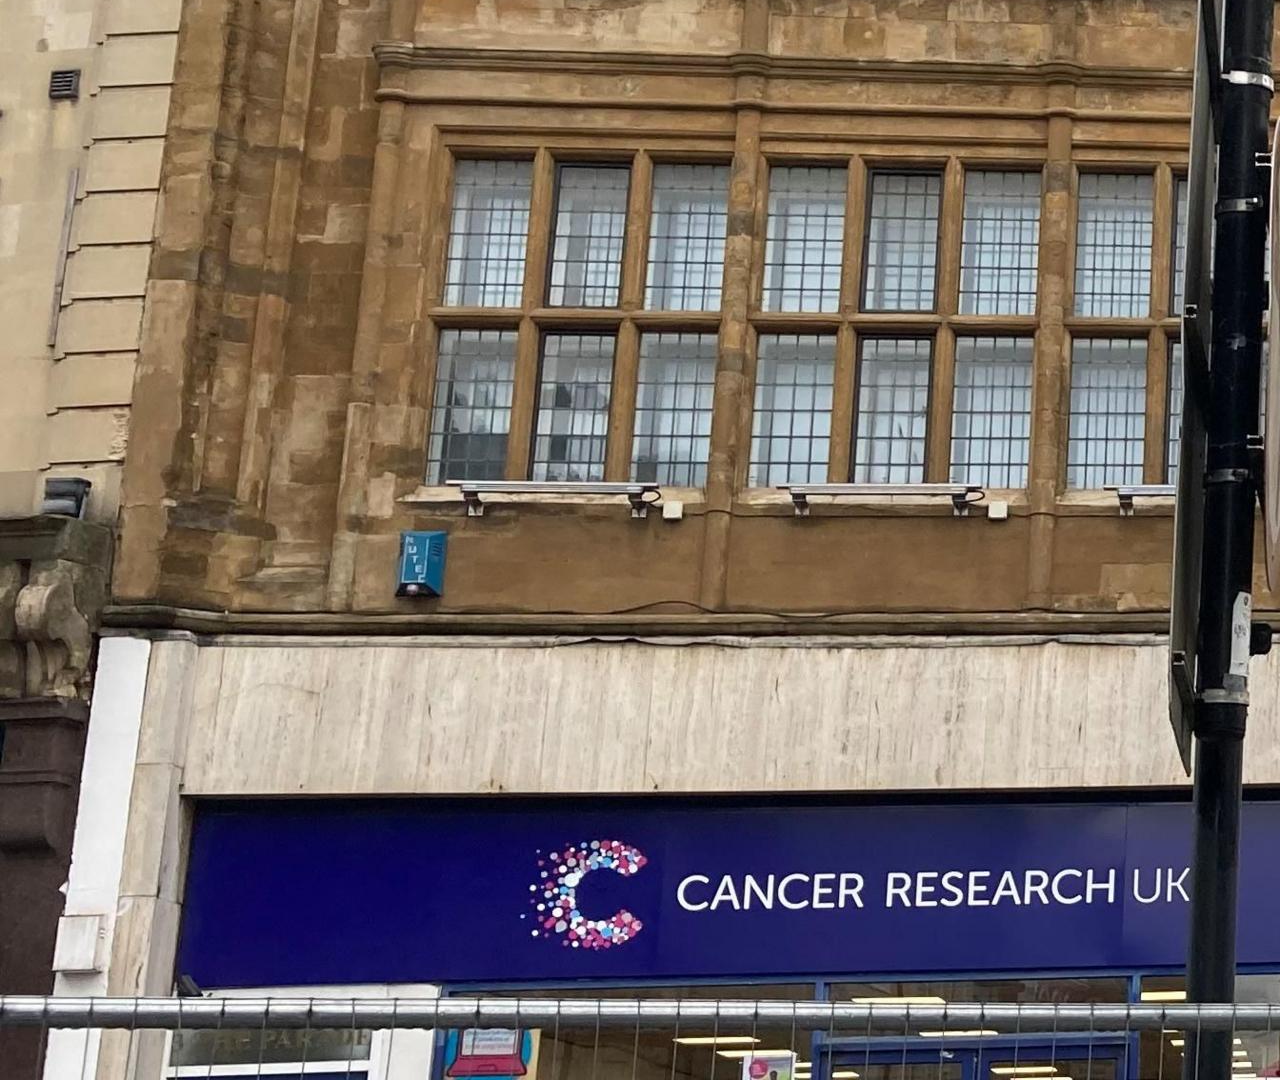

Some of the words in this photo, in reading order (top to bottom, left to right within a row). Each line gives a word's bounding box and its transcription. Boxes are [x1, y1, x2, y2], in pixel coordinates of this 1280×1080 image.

[677, 872, 865, 912] CANCER
[886, 868, 1116, 908] RESEARCH
[1133, 867, 1191, 903] UK
